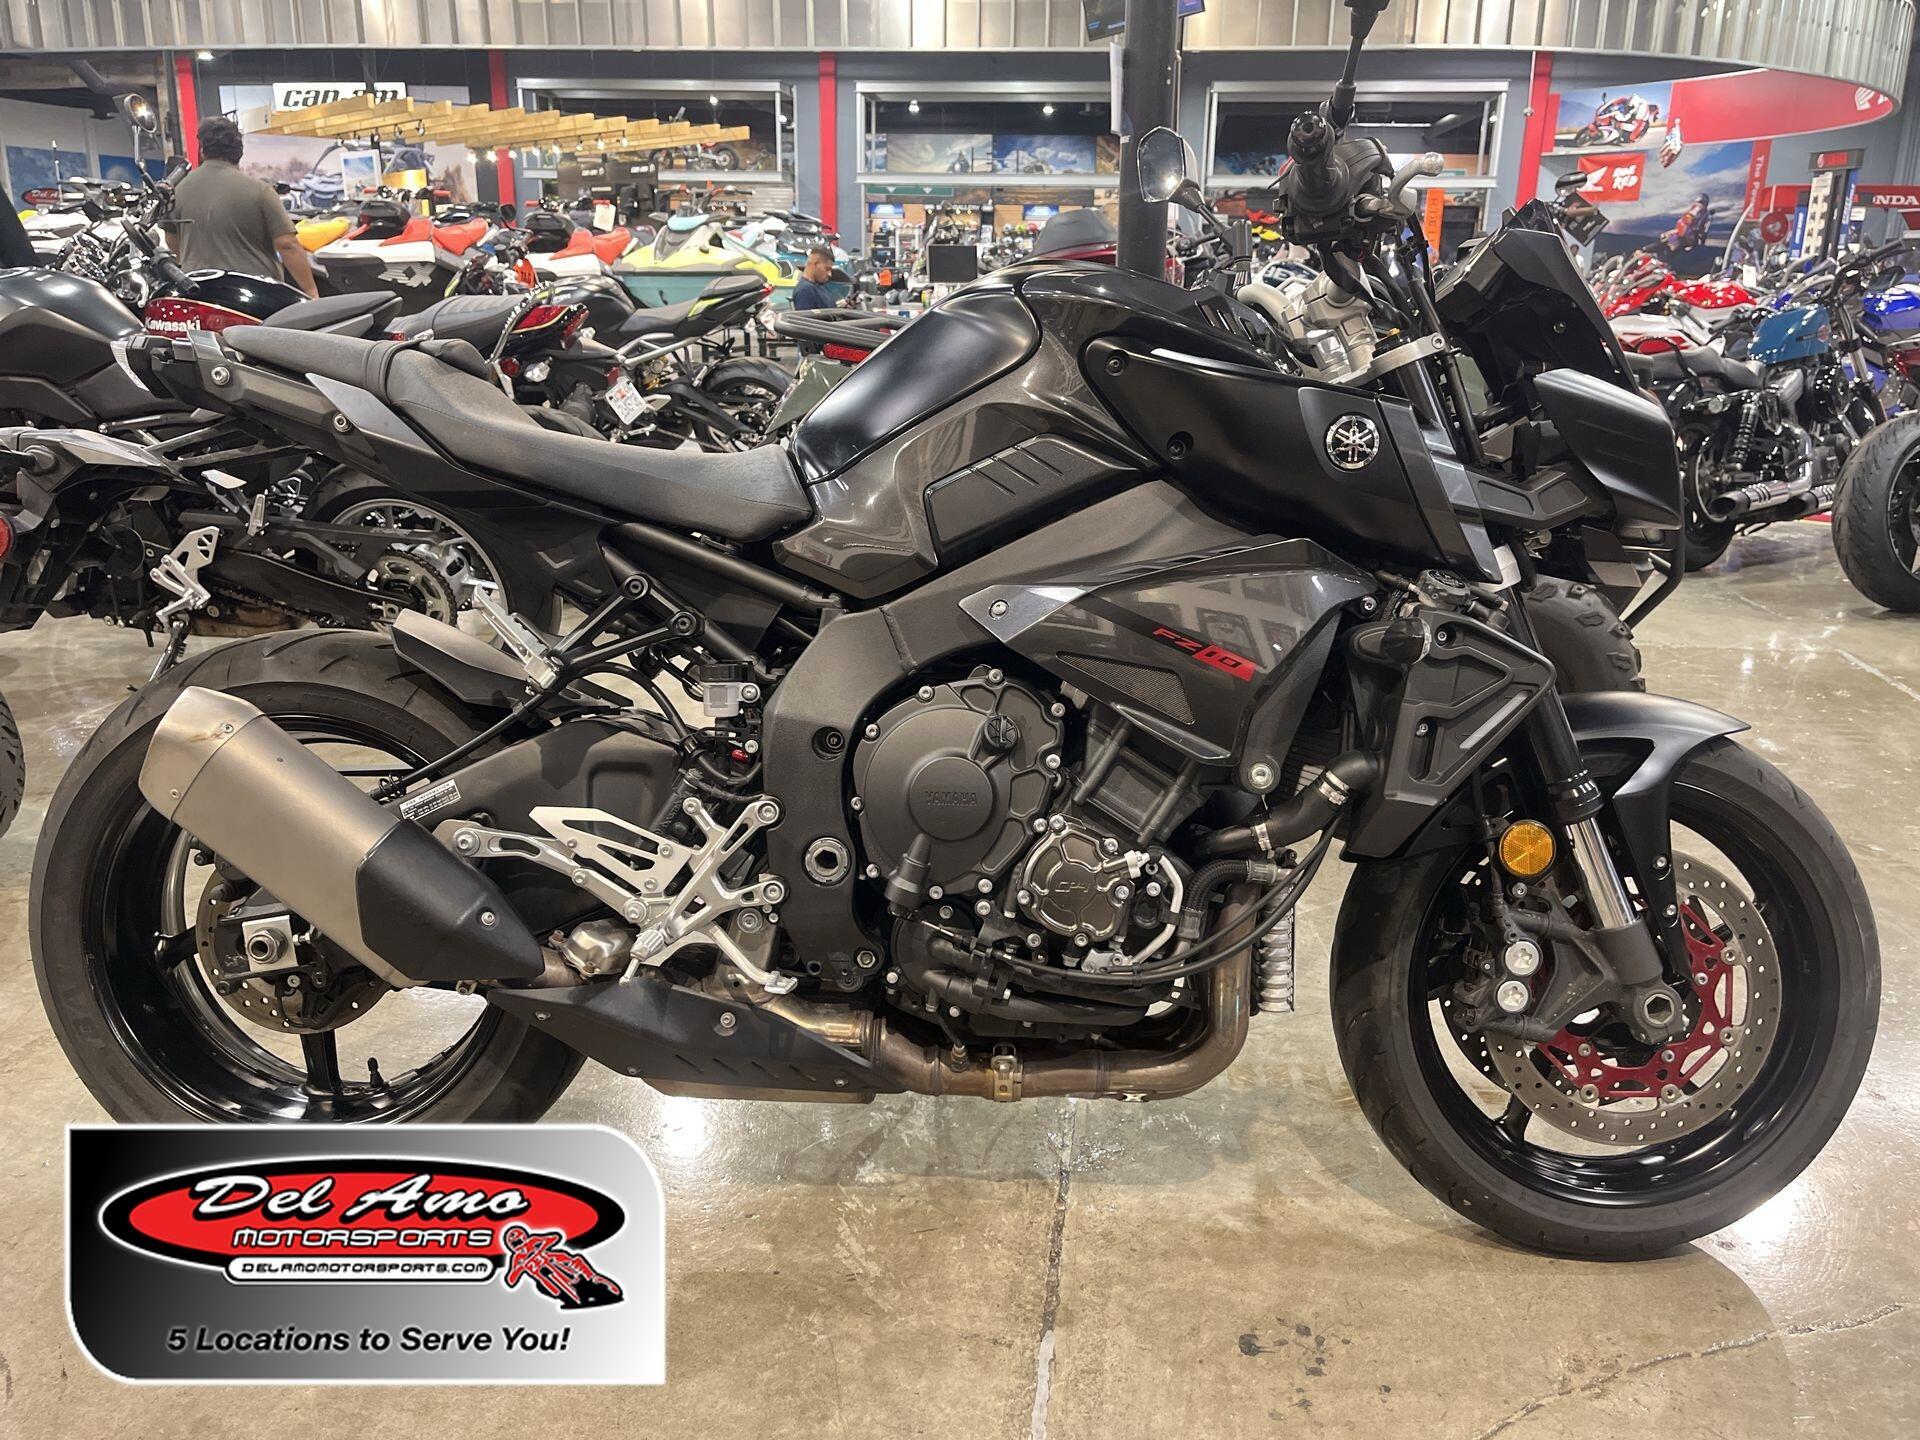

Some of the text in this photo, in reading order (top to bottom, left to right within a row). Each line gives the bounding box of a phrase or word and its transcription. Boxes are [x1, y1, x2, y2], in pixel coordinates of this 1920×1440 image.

[1872, 195, 1919, 205] NDA
[145, 317, 201, 331] Kawasaki
[925, 791, 978, 806] YAMAHA
